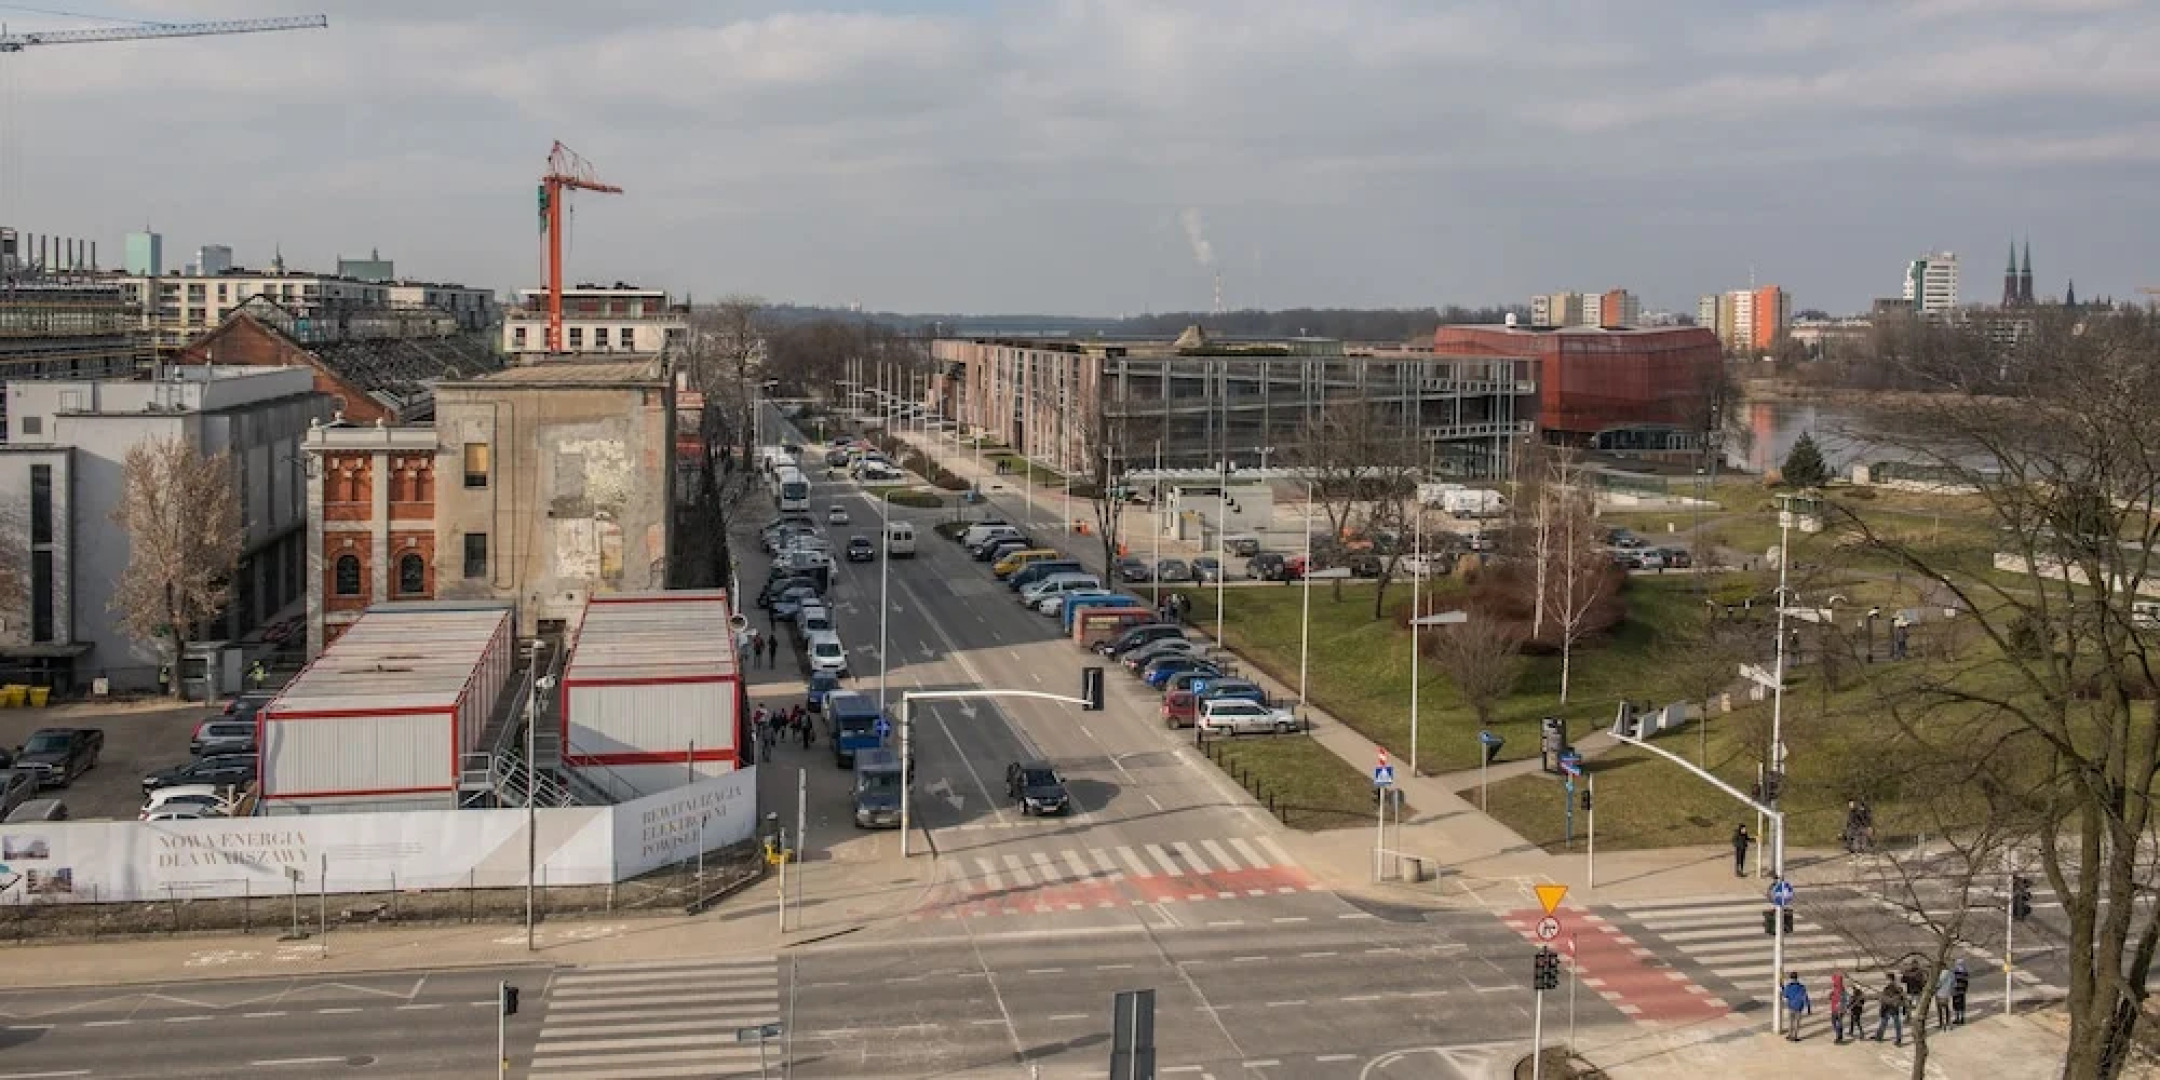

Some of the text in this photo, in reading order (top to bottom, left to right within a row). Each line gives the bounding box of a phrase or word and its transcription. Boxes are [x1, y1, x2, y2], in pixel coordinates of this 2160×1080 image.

[159, 831, 306, 848] NOWA ENERGIA
[159, 852, 199, 867] DLA
[203, 849, 308, 865] WARSZAWY
